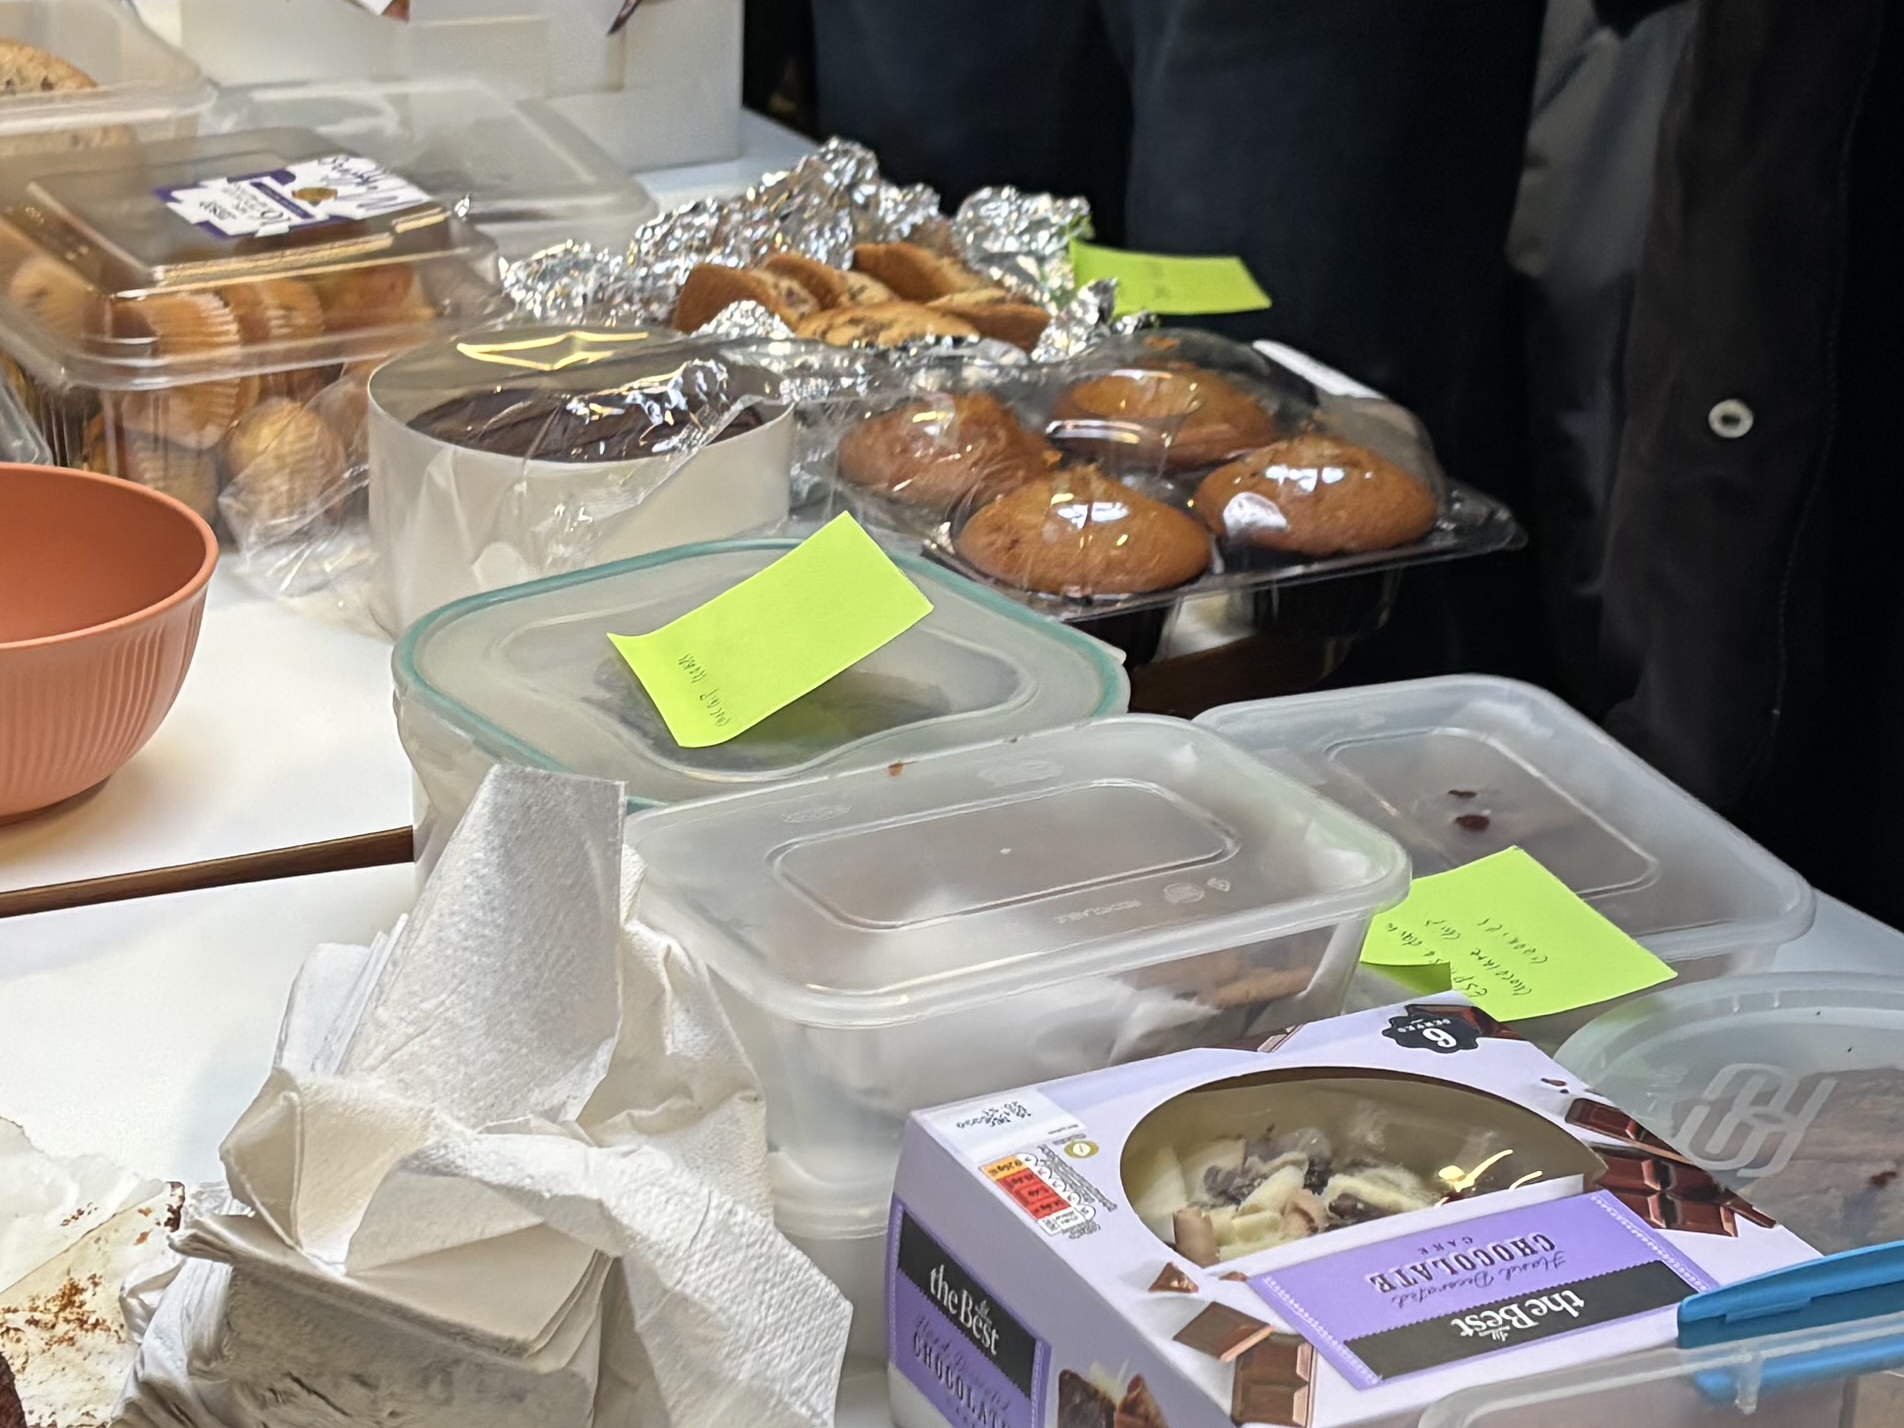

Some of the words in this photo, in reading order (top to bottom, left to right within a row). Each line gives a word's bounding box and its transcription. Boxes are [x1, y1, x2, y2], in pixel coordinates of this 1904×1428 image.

[1421, 1022, 1457, 1052] 6
[1364, 1230, 1556, 1291] CHOCOLATE
[1415, 1234, 1473, 1254] CAKE
[929, 1263, 961, 1314] the
[953, 1292, 1000, 1356] Best
[1448, 1303, 1535, 1344] Best
[1523, 1293, 1584, 1323] the
